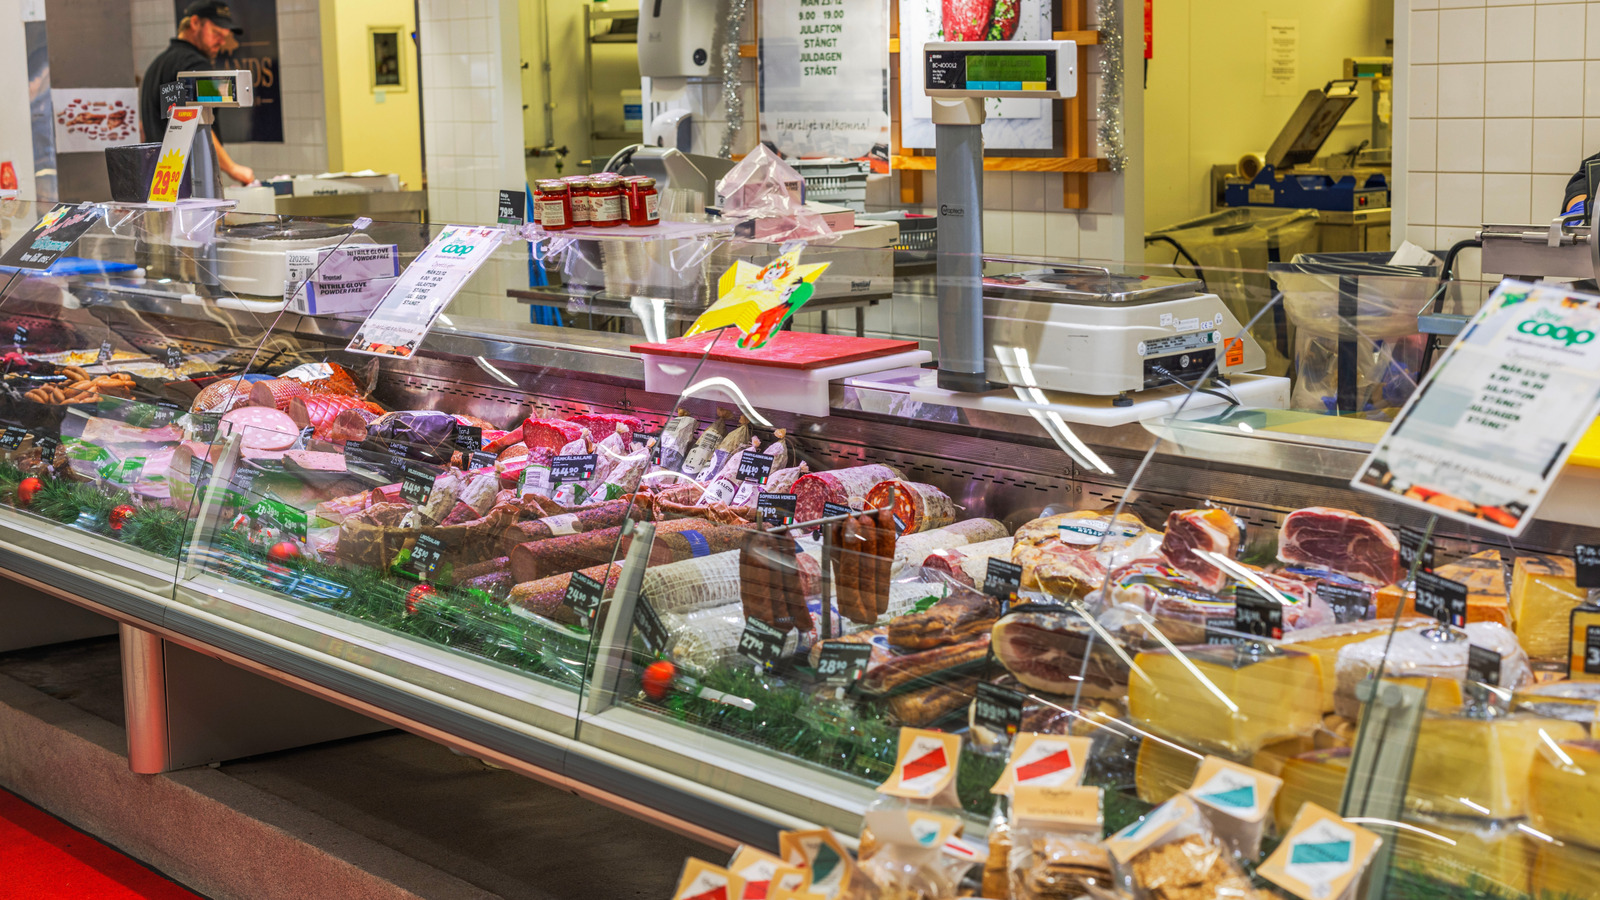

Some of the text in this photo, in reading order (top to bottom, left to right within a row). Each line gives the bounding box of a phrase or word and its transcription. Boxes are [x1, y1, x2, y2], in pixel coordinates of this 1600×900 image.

[799, 10, 844, 20] 9.00 19.00
[800, 24, 842, 34] JULAFTON
[804, 38, 838, 48] STÅNGT
[800, 52, 842, 62] JULDAGEN
[804, 66, 838, 76] STÅNGT
[442, 244, 474, 256] coop
[1517, 320, 1596, 347] coop
